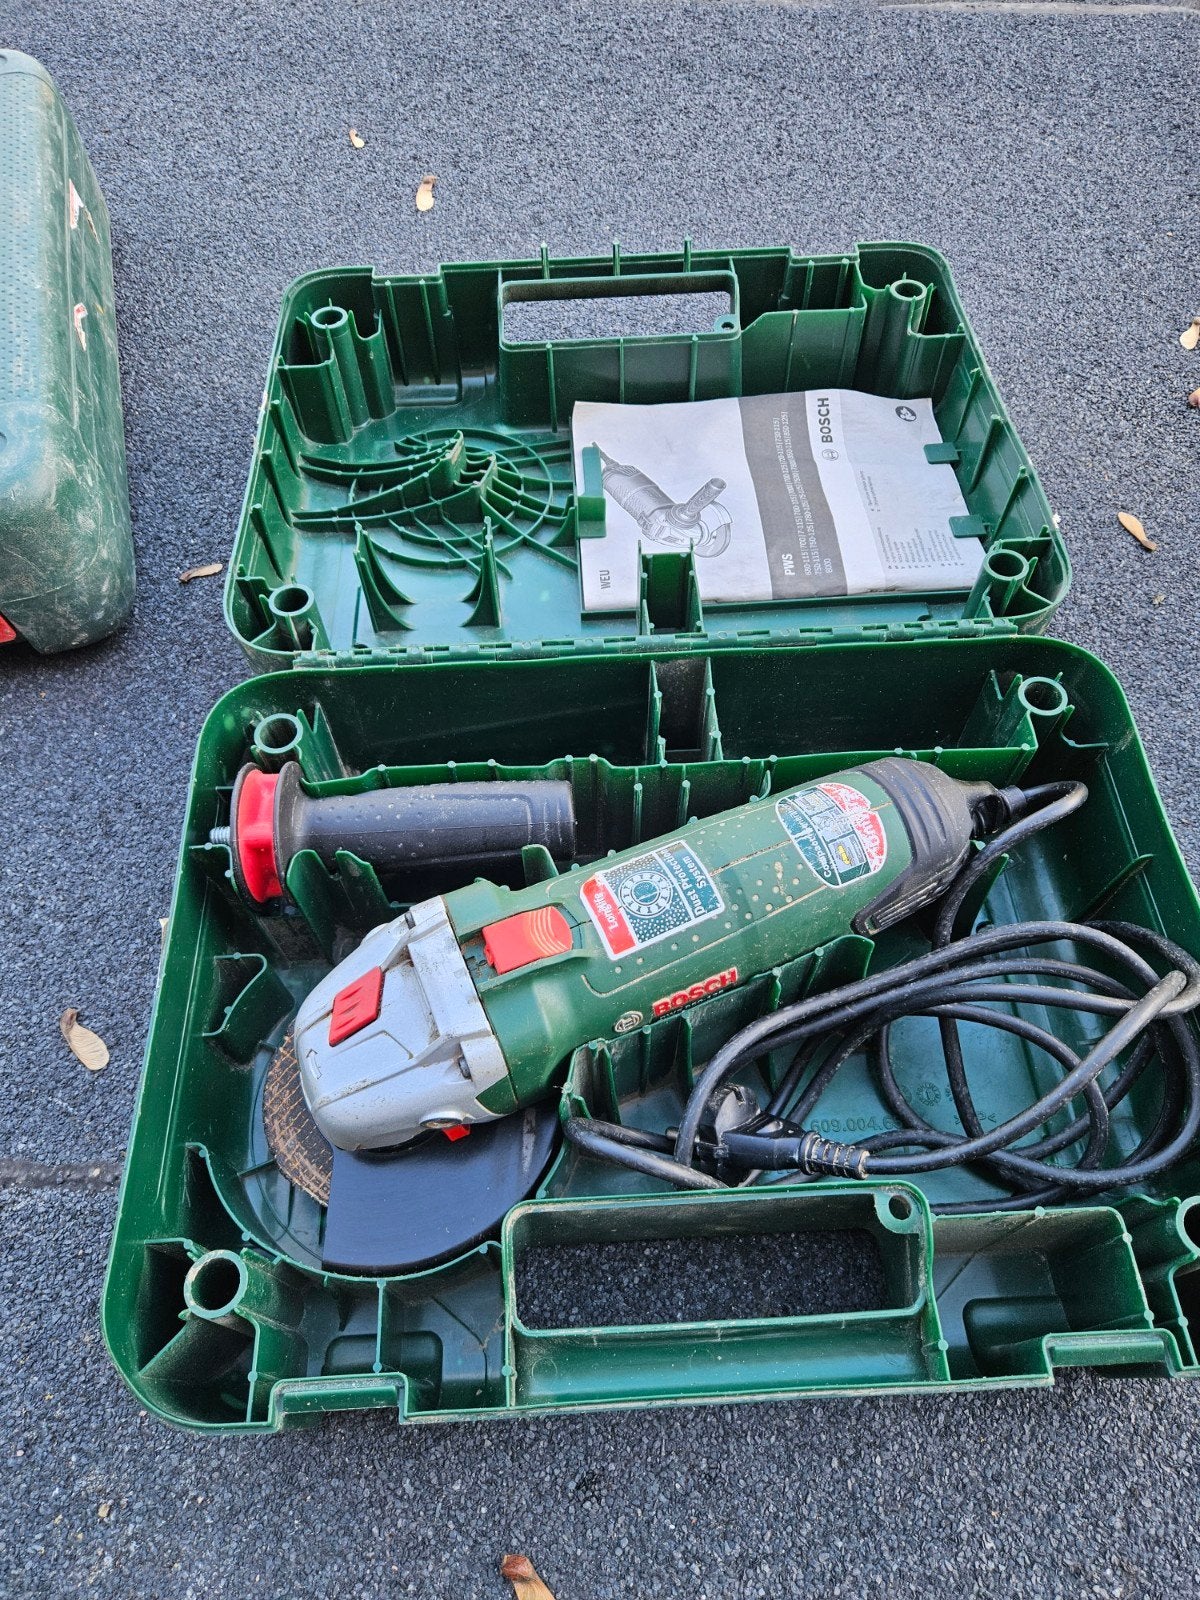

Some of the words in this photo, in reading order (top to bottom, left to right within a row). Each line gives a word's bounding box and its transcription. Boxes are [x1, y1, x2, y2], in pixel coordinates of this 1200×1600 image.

[817, 397, 834, 443] BOSCH
[599, 569, 611, 590] WEU
[781, 553, 796, 576] PWS
[661, 848, 692, 890] Protection
[683, 855, 707, 889] System
[594, 892, 619, 930] Longlife
[686, 890, 706, 918] Dust
[652, 967, 738, 1017] BOSCH
